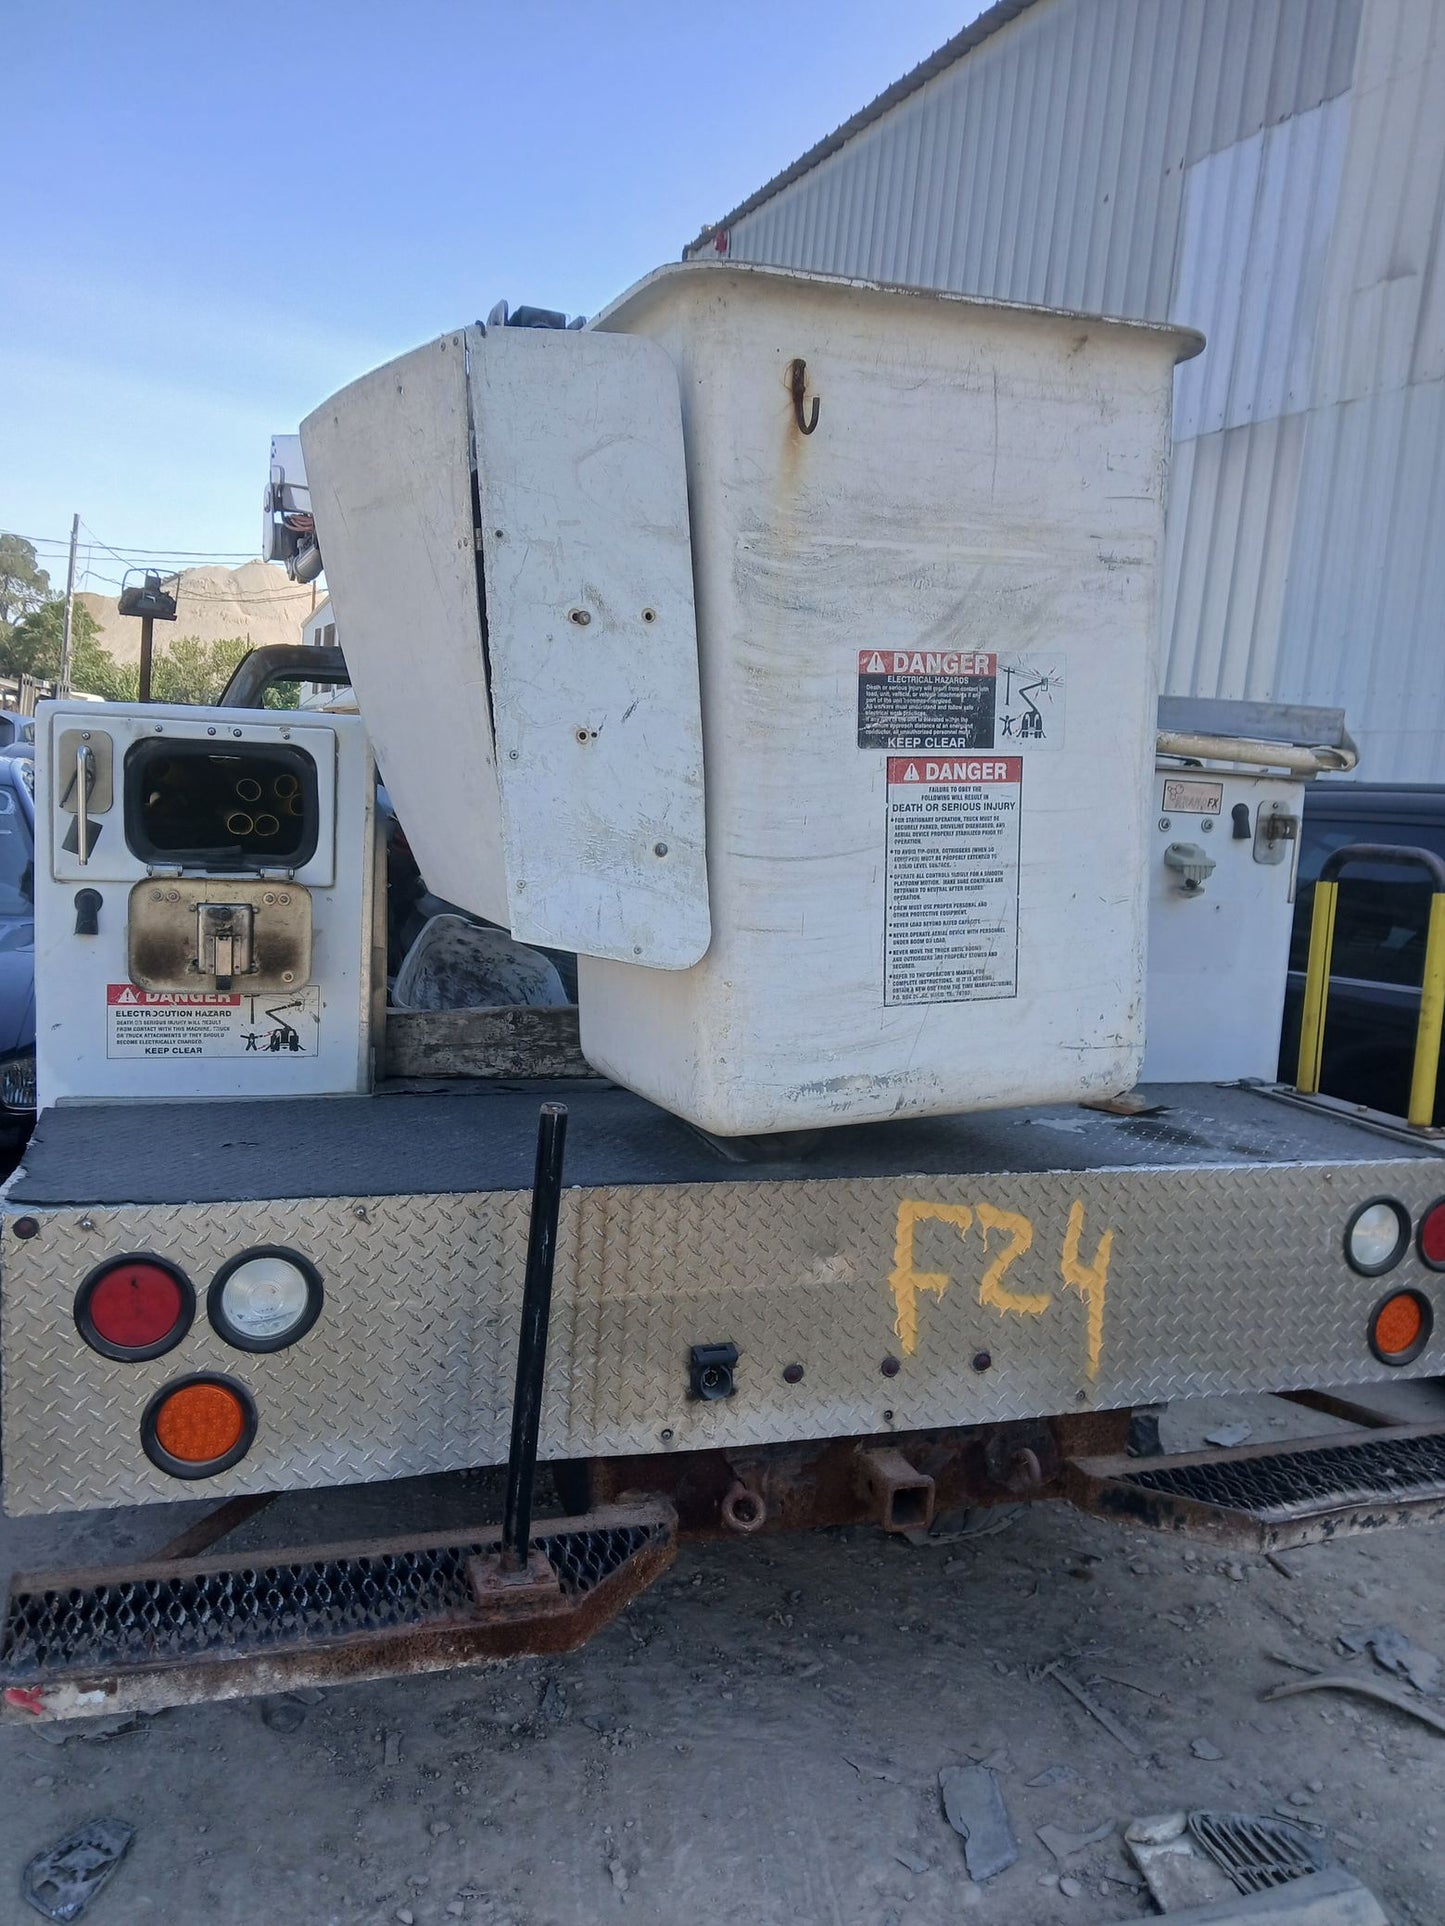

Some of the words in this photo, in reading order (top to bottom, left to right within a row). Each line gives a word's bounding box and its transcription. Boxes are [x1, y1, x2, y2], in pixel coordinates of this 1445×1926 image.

[893, 652, 989, 674] DANGER
[935, 676, 969, 684] HAZARDS
[888, 738, 921, 747] KEEP
[924, 738, 966, 747] CLEAR
[926, 762, 1007, 780] DANGER
[892, 804, 923, 812] DEATH
[925, 803, 939, 812] OR
[941, 802, 981, 811] SERIOUS
[983, 802, 1016, 810] INJURY
[887, 1199, 1113, 1378] F24
